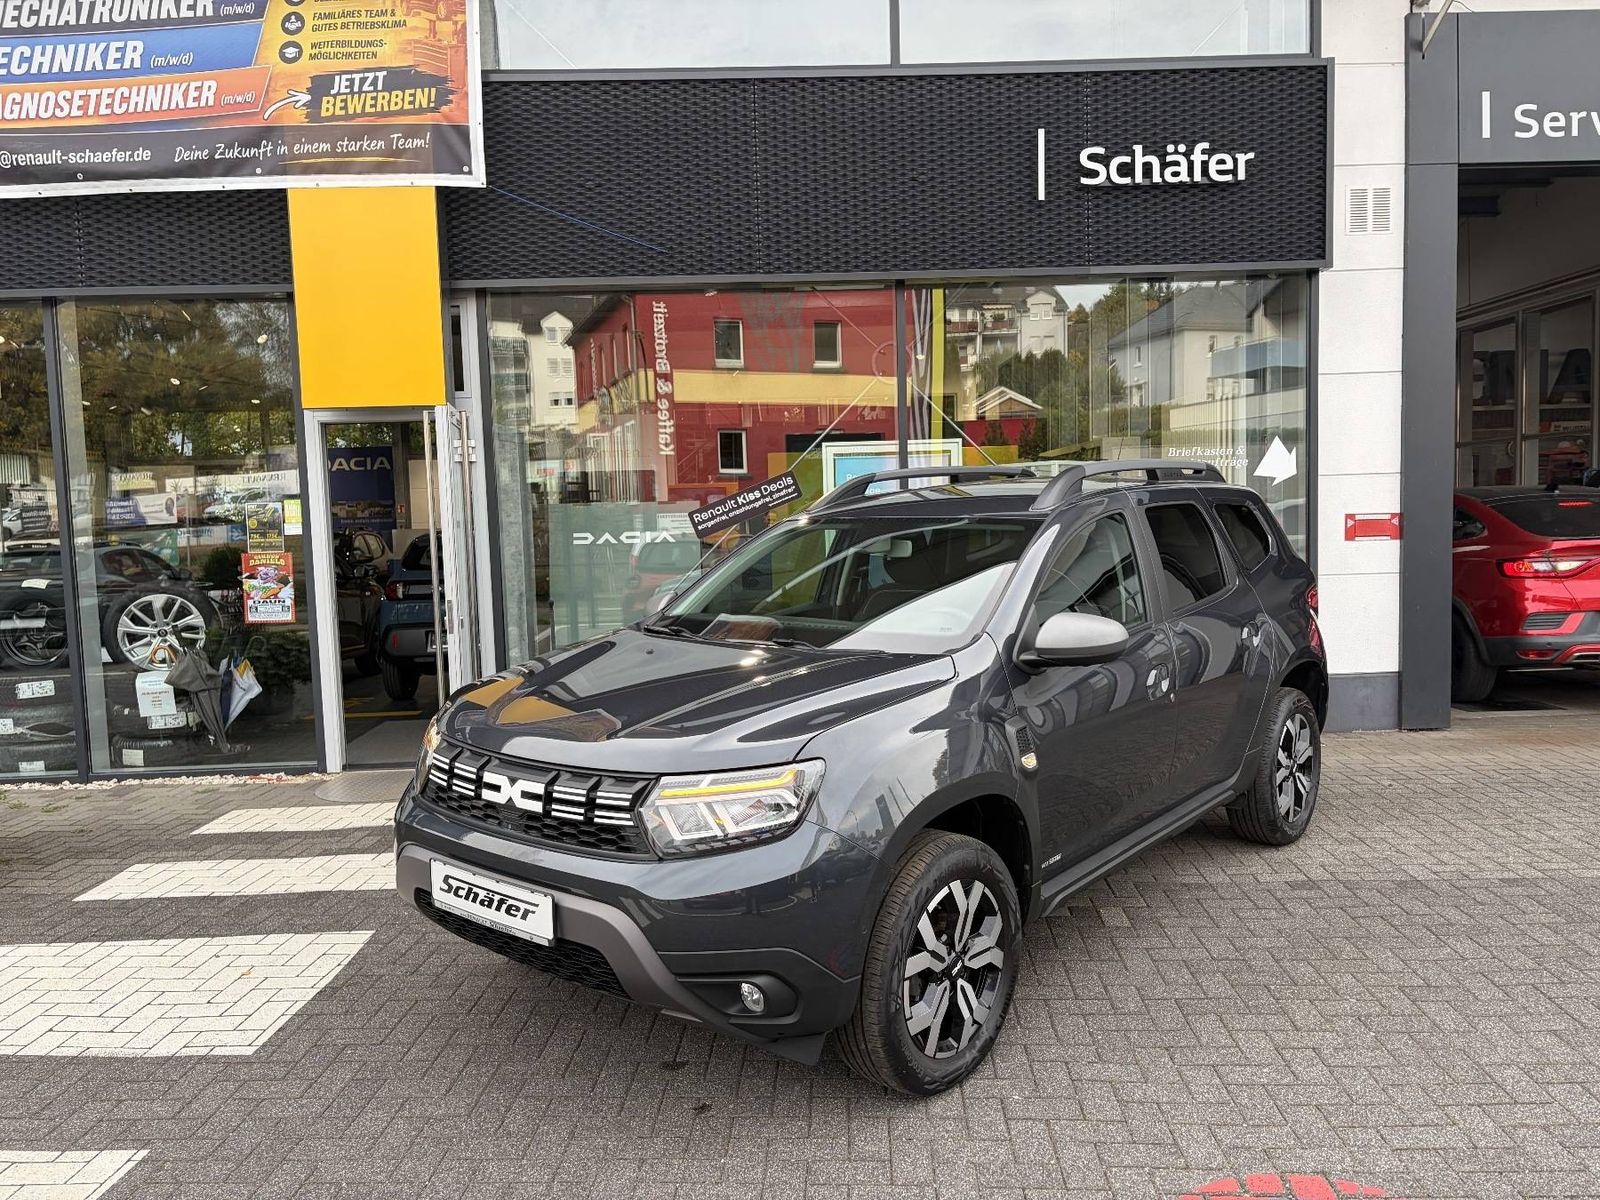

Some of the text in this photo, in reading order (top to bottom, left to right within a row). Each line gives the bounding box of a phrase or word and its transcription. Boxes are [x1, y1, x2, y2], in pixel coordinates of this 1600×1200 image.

[0, 0, 255, 28] ECHATRONIKER (m/w/d)
[312, 8, 396, 21] FAMILIÄRES TEAM &
[311, 19, 407, 32] GUTES BETRIEBSKLIMA
[310, 39, 387, 50] WEITERBILDUNGS-
[150, 52, 193, 68] (m/w/d)
[308, 50, 378, 61] MÖGLICHKEITEN
[330, 71, 387, 95] JETZT
[0, 80, 255, 119] GNOSETECHNIKER (m/w/d)
[320, 87, 437, 117] BEWERBEN!
[174, 132, 431, 163] Deine Zukunft in einem starken Team!
[0, 147, 151, 168] @renault-schaefer.de
[1079, 142, 1255, 185] Schäfer
[1168, 445, 1247, 458] Briefkasten &
[328, 456, 391, 471] ACIA
[693, 499, 737, 524] Renault
[736, 490, 761, 506] Kiss
[761, 476, 794, 495] Deals
[697, 514, 729, 530] sorgenfrei,
[573, 531, 676, 545] DACIA
[439, 874, 538, 922] Schäfer
